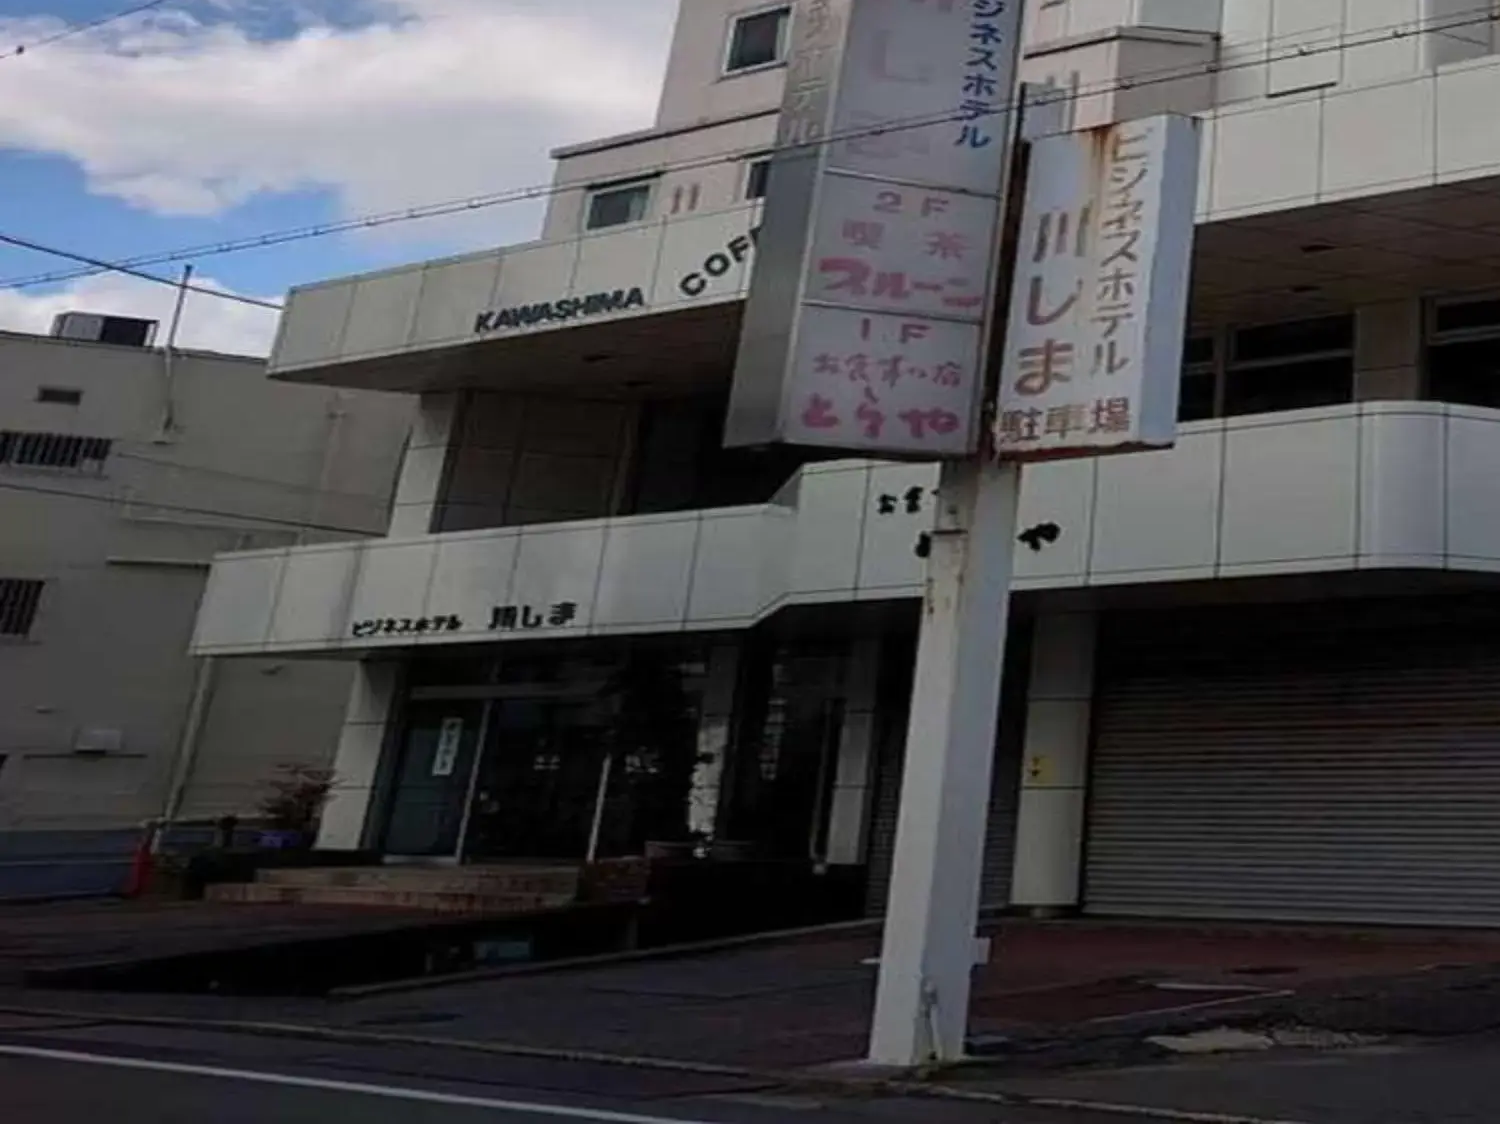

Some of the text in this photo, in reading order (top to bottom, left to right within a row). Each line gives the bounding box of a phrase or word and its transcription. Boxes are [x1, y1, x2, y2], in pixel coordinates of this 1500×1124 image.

[1090, 126, 1152, 377] ビジネスホテル
[474, 287, 645, 334] KAWASHIMA
[1014, 200, 1094, 396] 川しま
[803, 386, 960, 439] とらや
[1000, 397, 1131, 443] 駐車場
[352, 613, 462, 638] ビジネスホテル
